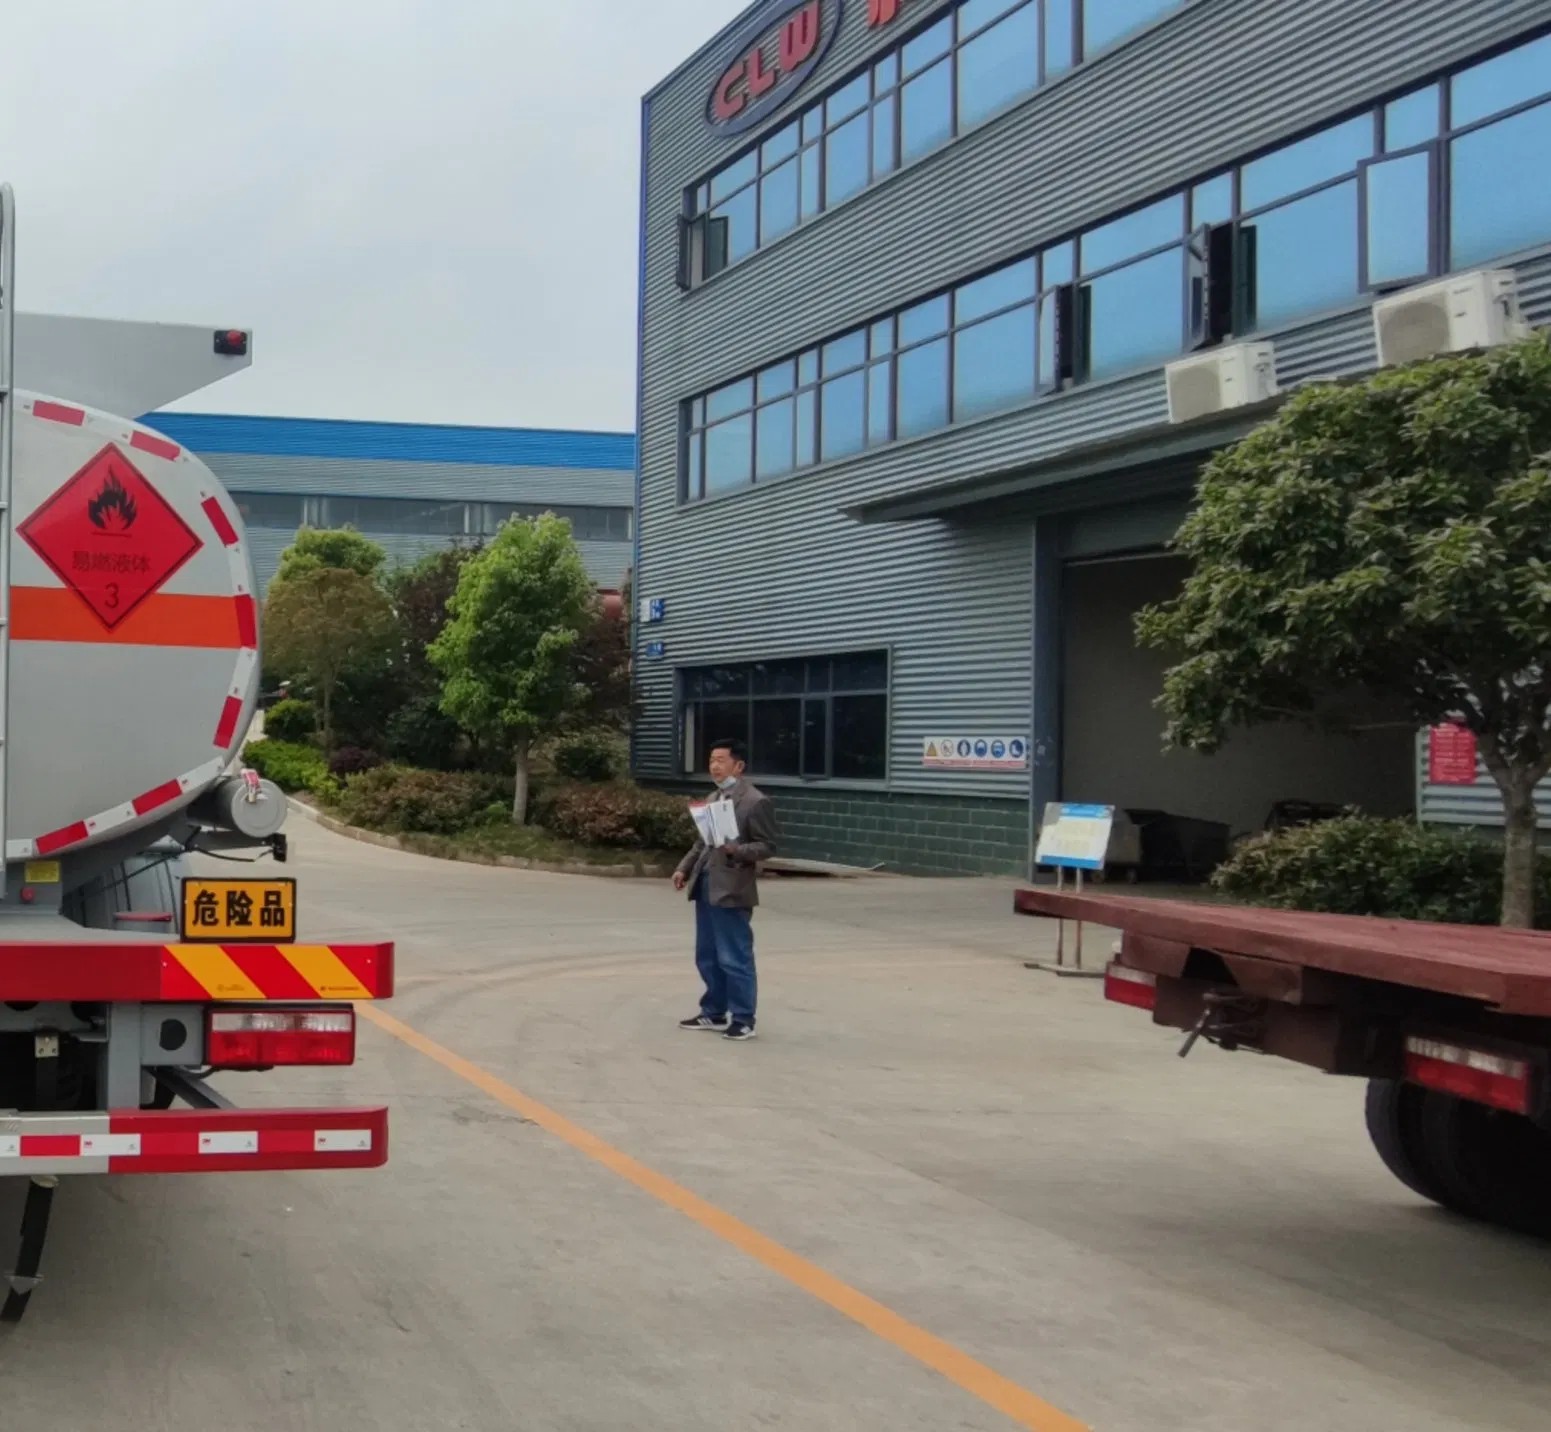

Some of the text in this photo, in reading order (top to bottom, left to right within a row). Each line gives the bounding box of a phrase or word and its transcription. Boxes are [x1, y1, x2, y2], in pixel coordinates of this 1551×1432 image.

[713, 0, 822, 119] CLW
[104, 582, 119, 609] 3
[191, 889, 285, 927] 危险品
